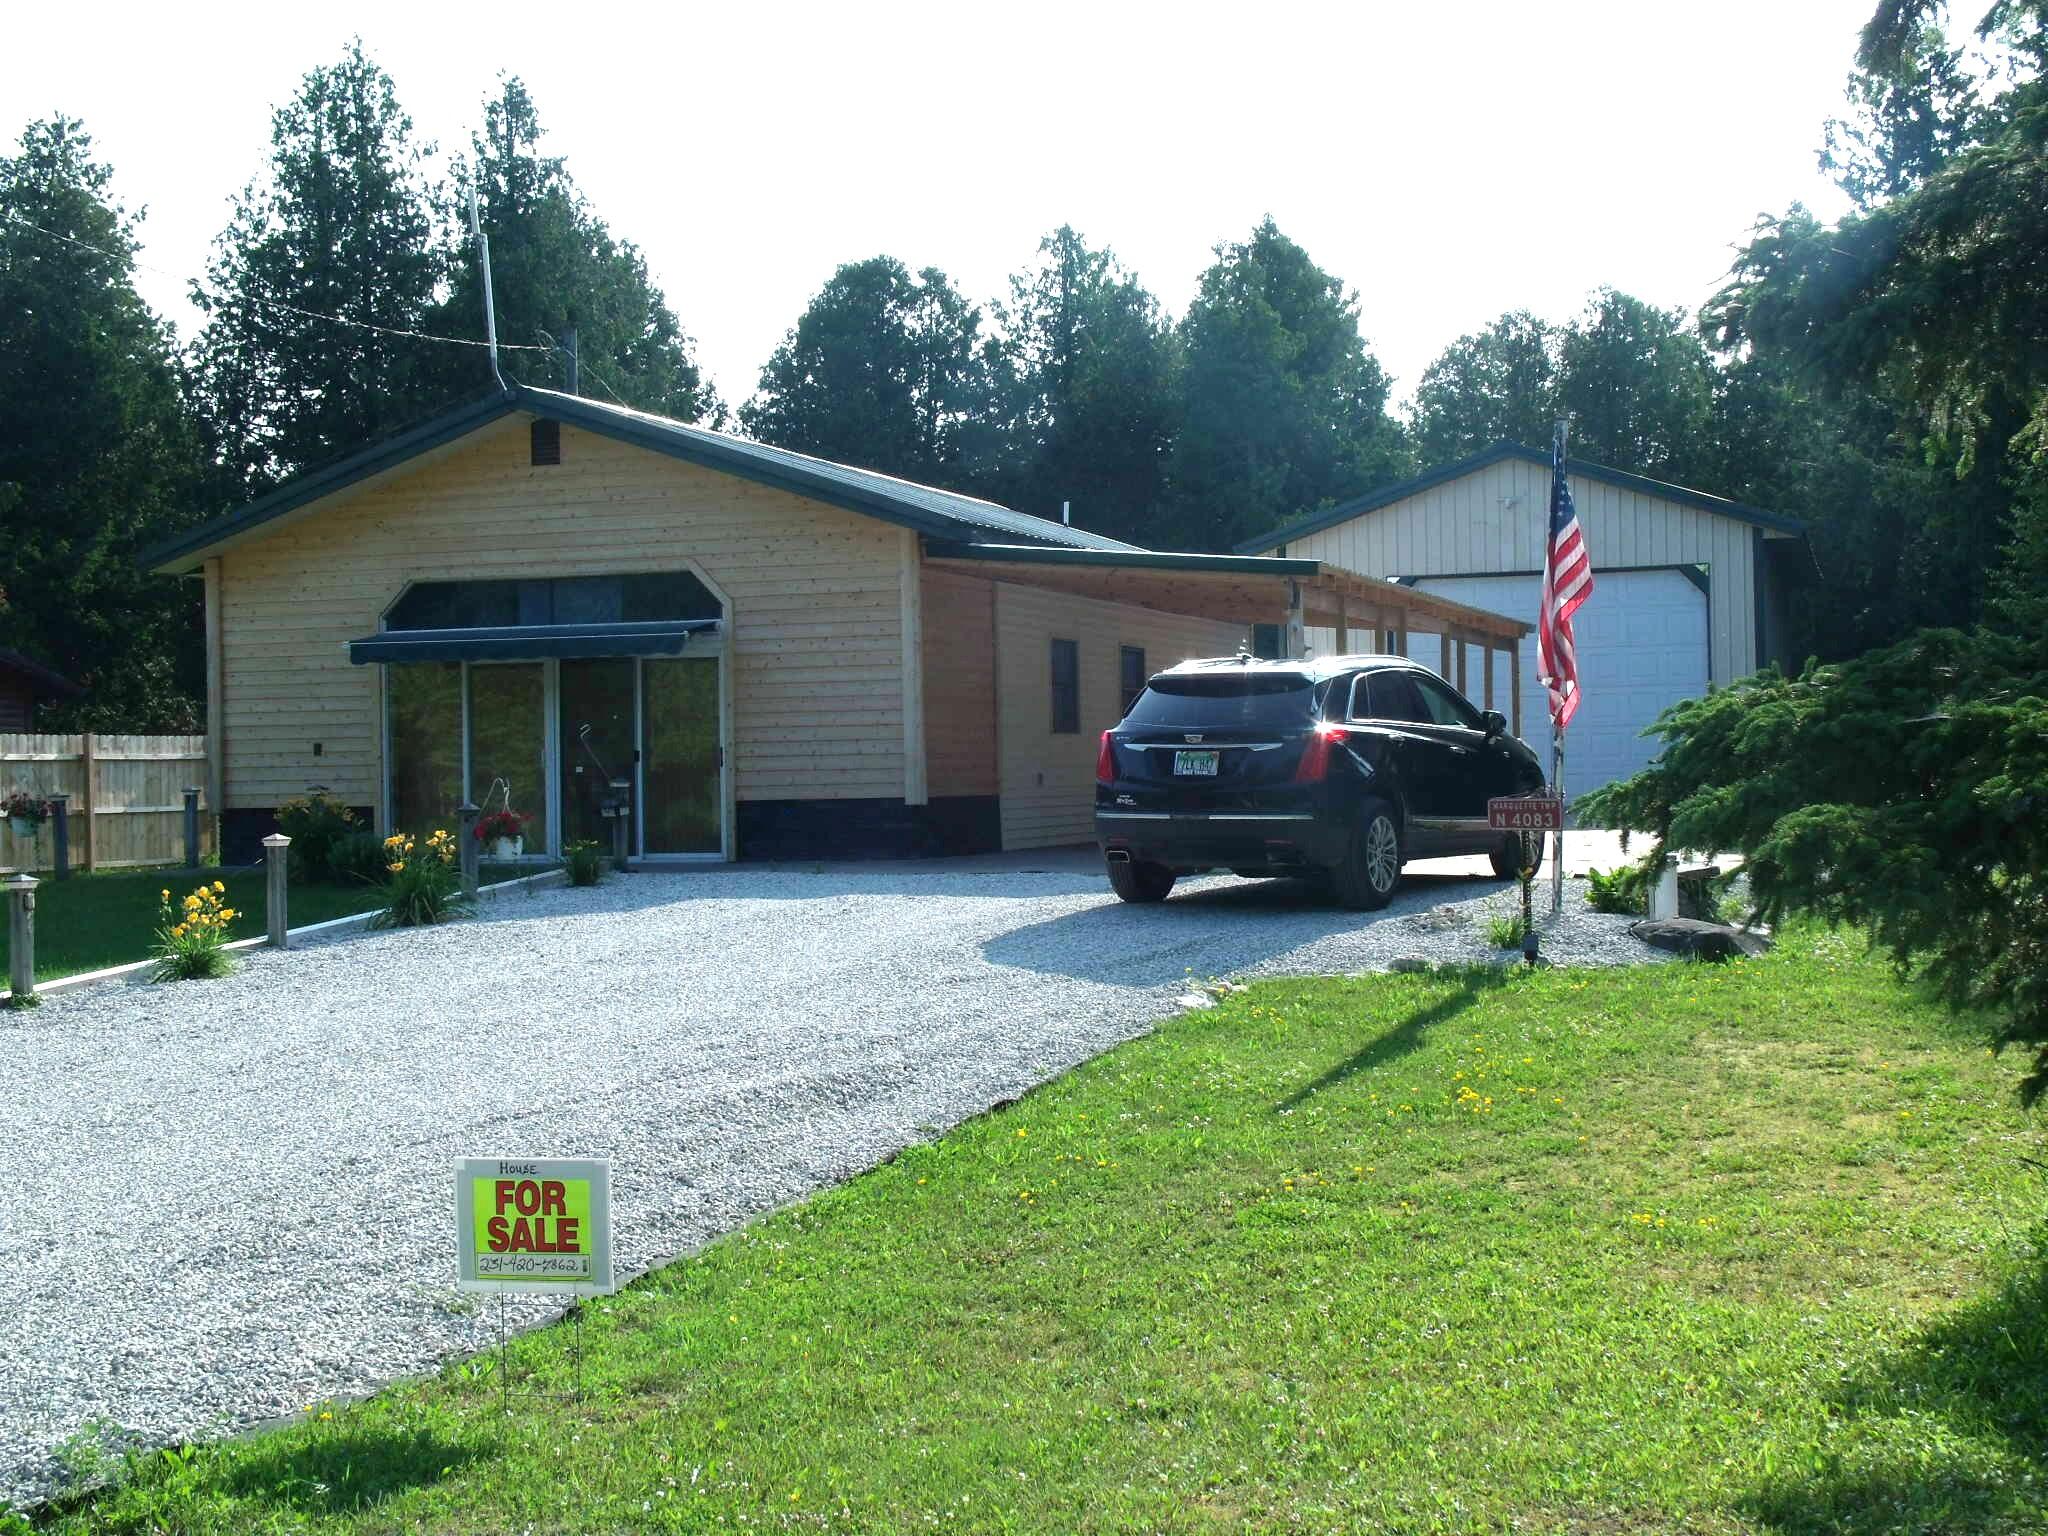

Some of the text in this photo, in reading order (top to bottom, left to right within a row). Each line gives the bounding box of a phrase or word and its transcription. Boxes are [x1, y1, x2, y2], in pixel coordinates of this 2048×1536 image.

[1496, 813, 1553, 827] N 4083
[495, 1179, 567, 1216] FOR
[487, 1216, 580, 1253] SALE
